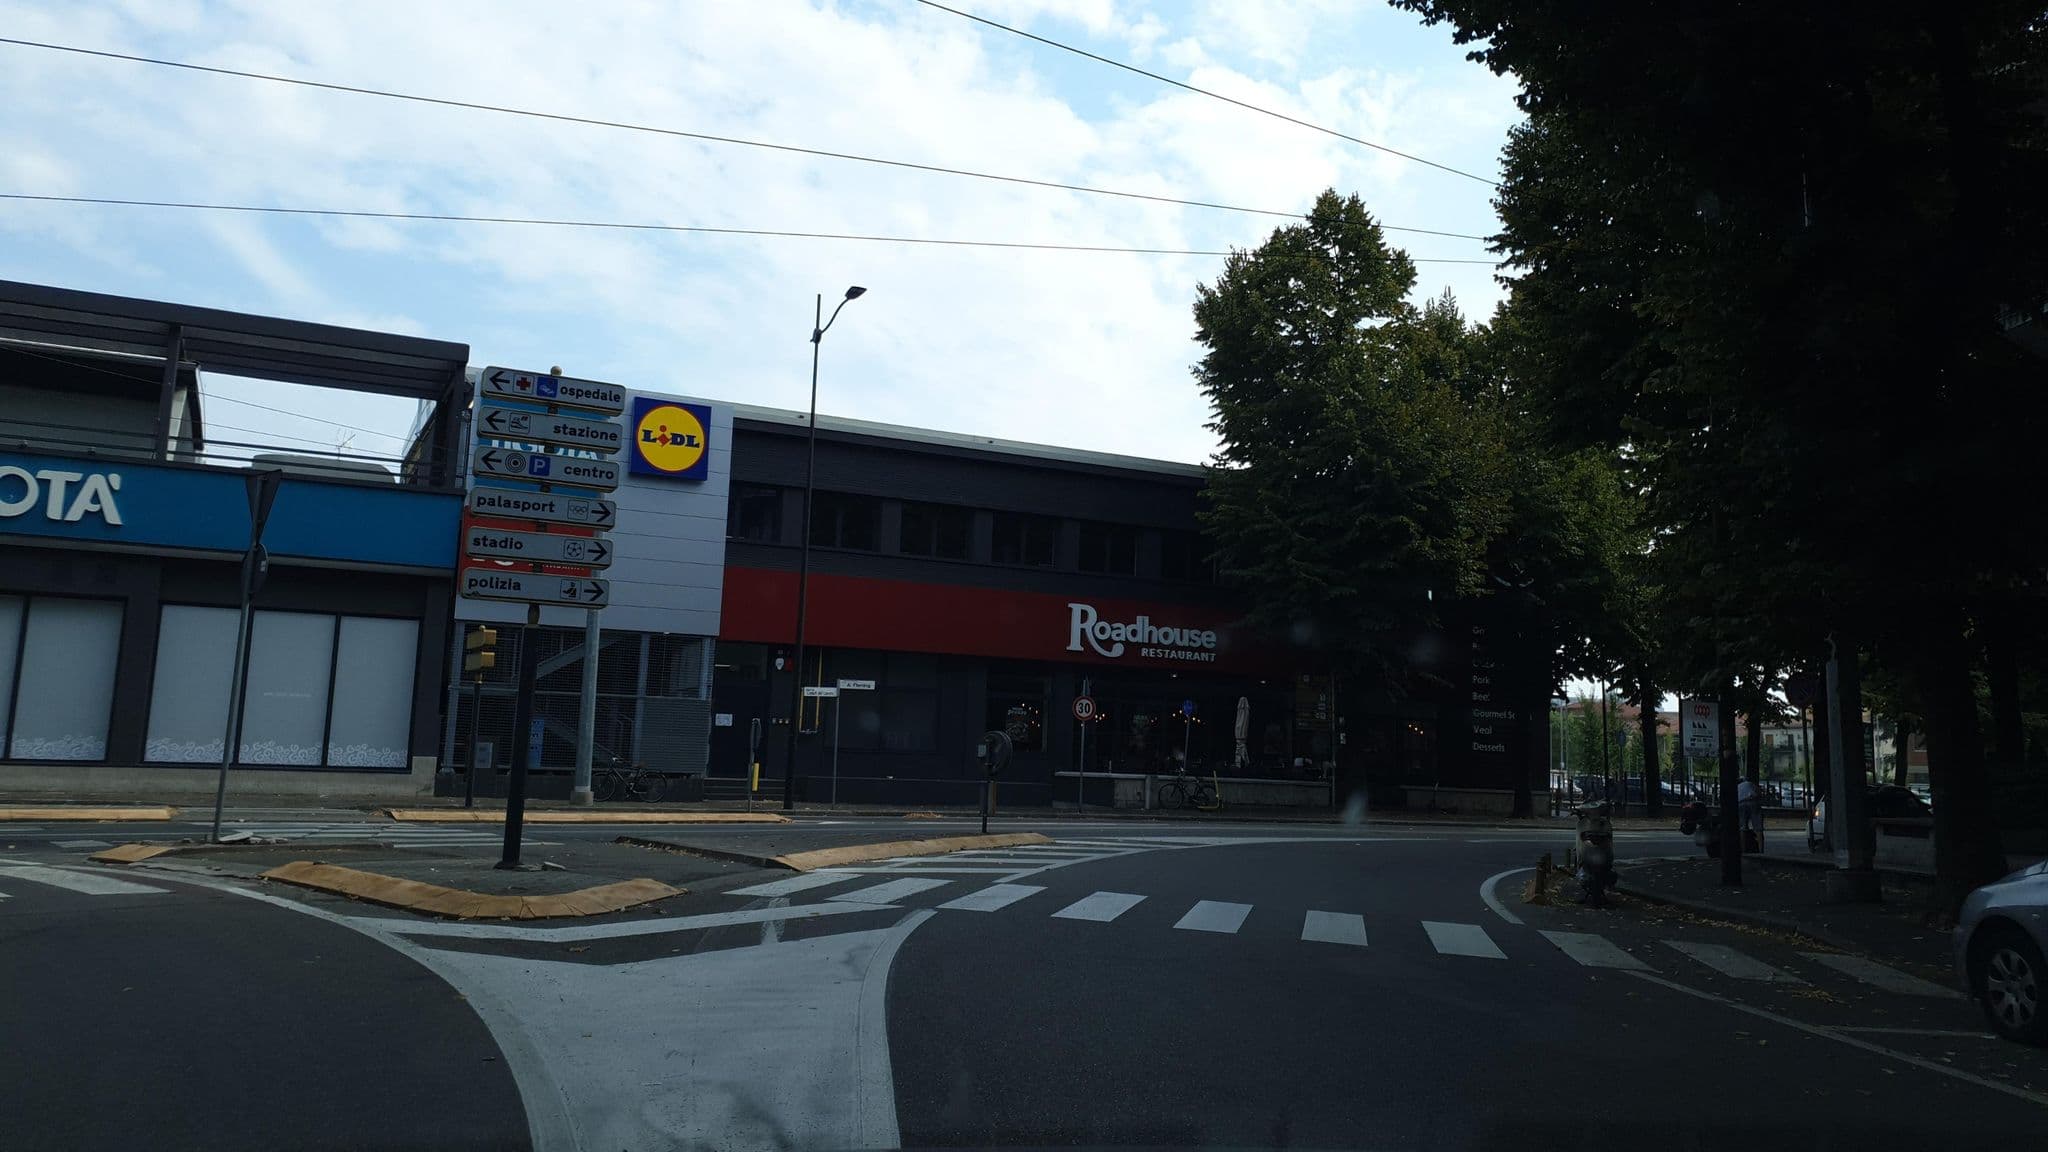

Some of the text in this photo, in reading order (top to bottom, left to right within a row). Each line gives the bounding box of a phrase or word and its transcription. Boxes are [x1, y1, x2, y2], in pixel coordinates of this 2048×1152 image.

[560, 384, 621, 403] ospedale
[553, 422, 618, 442] stazione
[563, 465, 615, 480] centro
[476, 495, 556, 513] palasport
[472, 535, 524, 550] stadio
[467, 576, 522, 592] polizia
[1066, 602, 1217, 658] Roadhouse
[1141, 647, 1217, 663] RESTAURANT
[1078, 702, 1091, 714] 30
